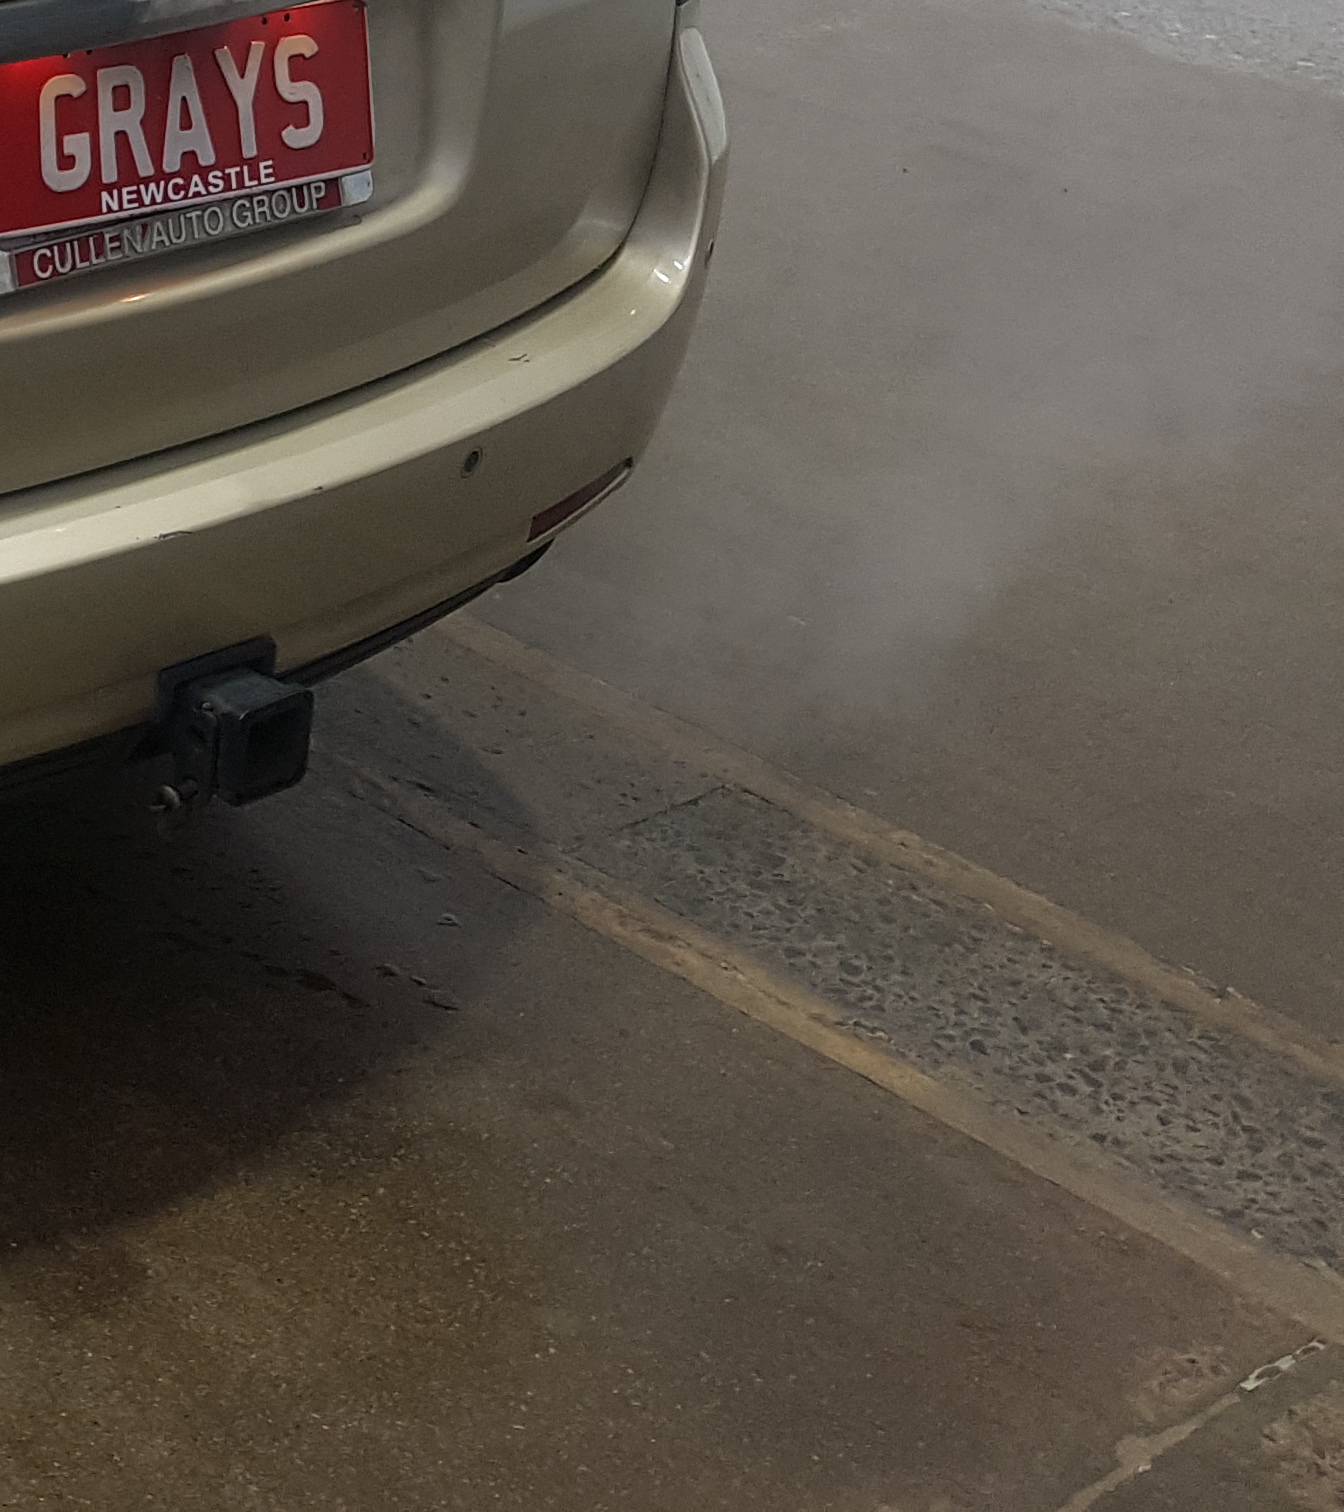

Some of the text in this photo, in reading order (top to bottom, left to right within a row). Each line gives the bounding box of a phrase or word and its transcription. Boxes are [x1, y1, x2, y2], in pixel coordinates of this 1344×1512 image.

[37, 33, 325, 194] GRAYS
[32, 181, 328, 280] CULLEN AUTO GROUP
[100, 159, 276, 214] NEWCASTLE
